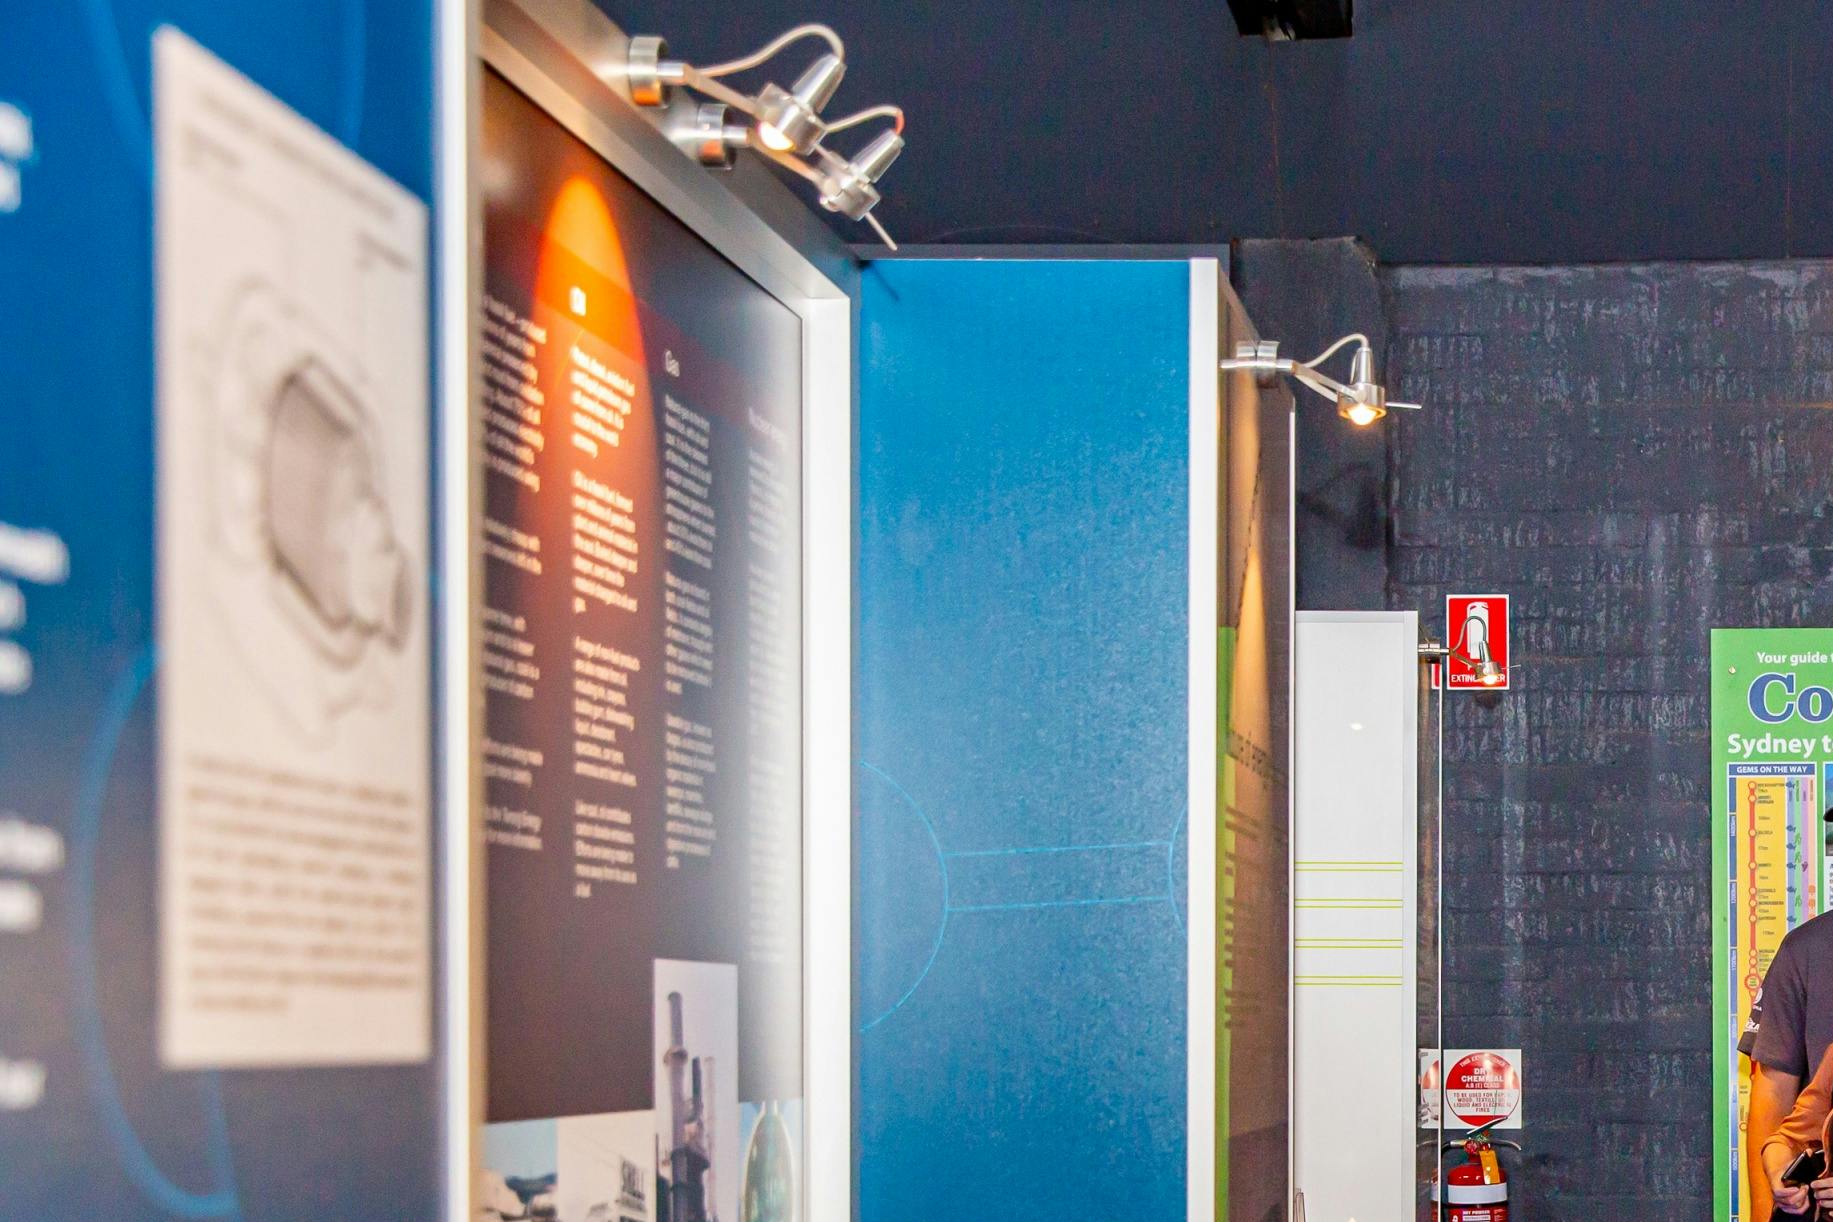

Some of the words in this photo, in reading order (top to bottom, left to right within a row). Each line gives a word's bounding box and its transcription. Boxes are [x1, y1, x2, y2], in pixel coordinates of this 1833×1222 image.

[1756, 651, 1788, 664] Your
[1790, 650, 1829, 666] guide
[1451, 674, 1506, 683] EXTINER
[1727, 733, 1815, 758] Sydney
[1736, 766, 1758, 774] GEMS
[1759, 766, 1771, 774] ON
[1773, 766, 1788, 774] THE
[1789, 766, 1808, 774] WAY
